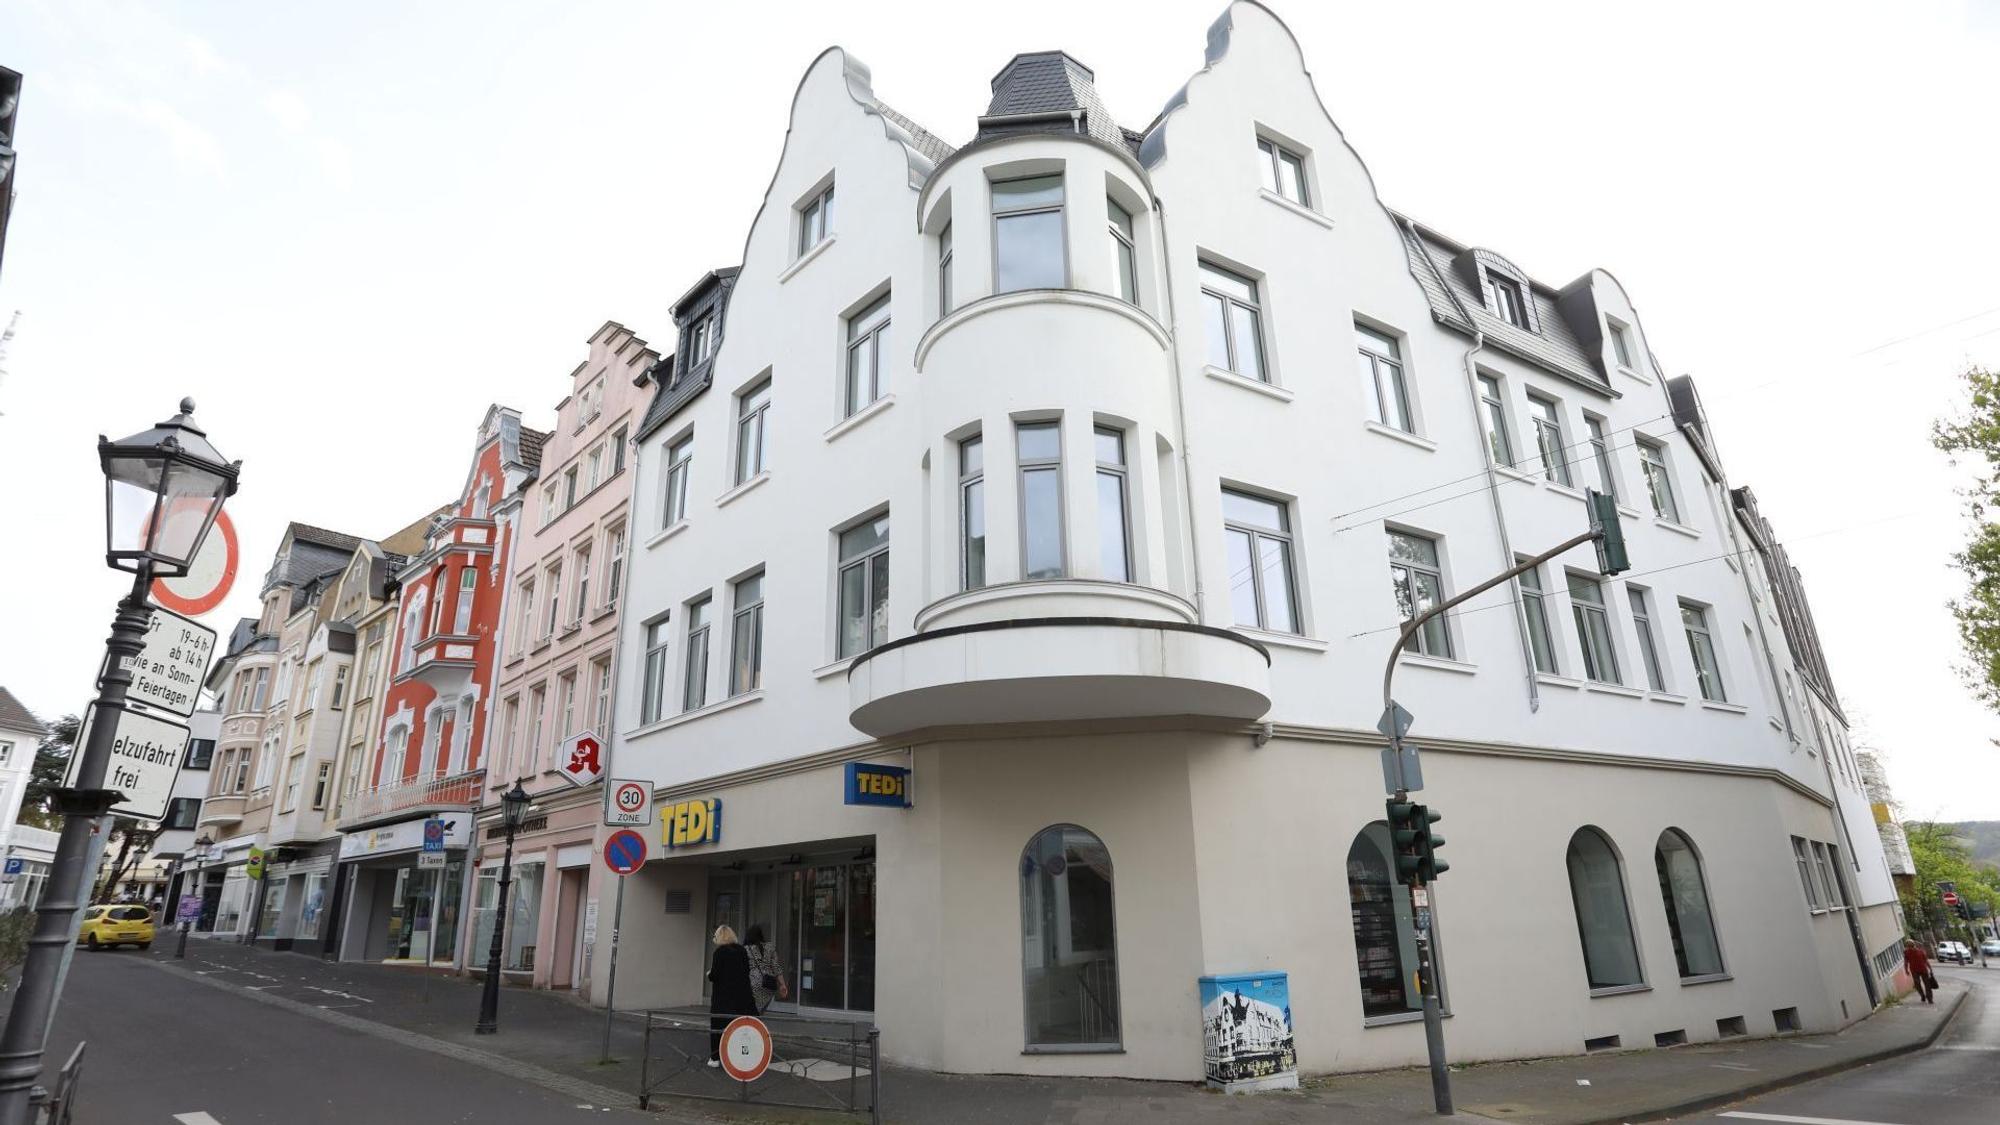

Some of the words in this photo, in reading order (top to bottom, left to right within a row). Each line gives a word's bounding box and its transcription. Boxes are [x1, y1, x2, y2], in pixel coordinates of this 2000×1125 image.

[181, 629, 201, 648] 19-6
[169, 646, 181, 660] ab
[185, 650, 195, 666] 14
[195, 655, 202, 668] h
[152, 662, 164, 675] an
[168, 665, 195, 685] Sonn-
[137, 676, 187, 705] Feiertagen
[113, 765, 141, 789] frei
[857, 772, 902, 796] TEDi
[621, 791, 639, 805] 30
[617, 813, 640, 823] ZONE
[660, 798, 719, 847] TEDi
[425, 842, 442, 851] TAXI
[7, 860, 20, 872] P
